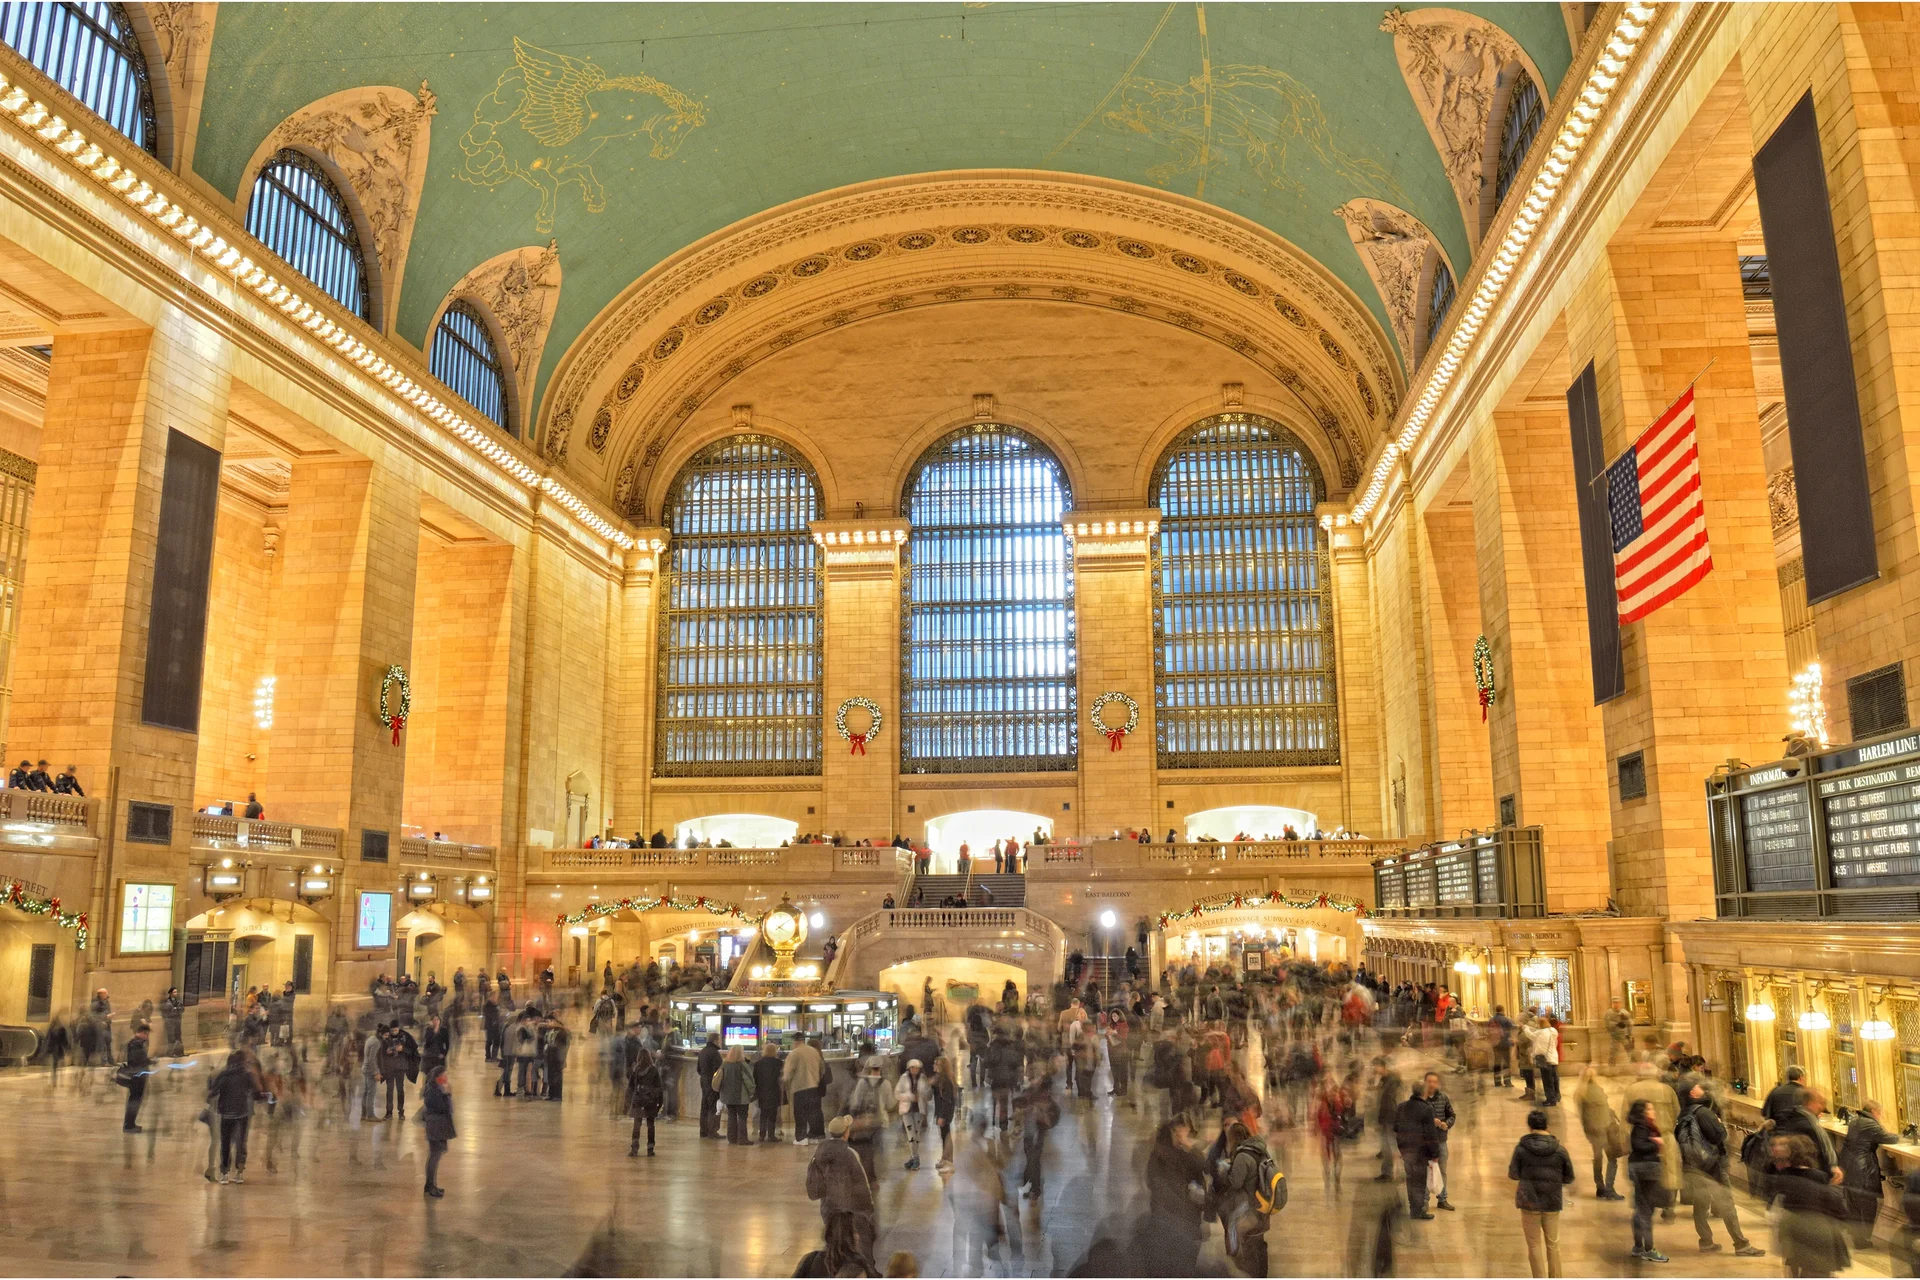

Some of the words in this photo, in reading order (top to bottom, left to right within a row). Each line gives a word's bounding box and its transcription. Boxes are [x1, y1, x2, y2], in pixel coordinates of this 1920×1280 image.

[1858, 741, 1895, 762] HARLEM
[1895, 736, 1917, 754] LINE
[1820, 782, 1835, 794] TIME
[1838, 779, 1852, 791] TRK
[1853, 770, 1897, 788] DESTINATION
[1888, 823, 1908, 836] PLAINS
[1890, 841, 1910, 854] PLAINS
[1244, 888, 1260, 897] AVE
[1289, 888, 1318, 897] TICKET
[683, 921, 706, 931] STREET
[707, 919, 735, 927] PASSAGE
[1203, 917, 1229, 927] STREET
[1263, 915, 1294, 924] SUBWAY
[1535, 932, 1562, 940] SERVICE
[967, 950, 989, 958] DINING
[990, 952, 1023, 966] CONCOURSE
